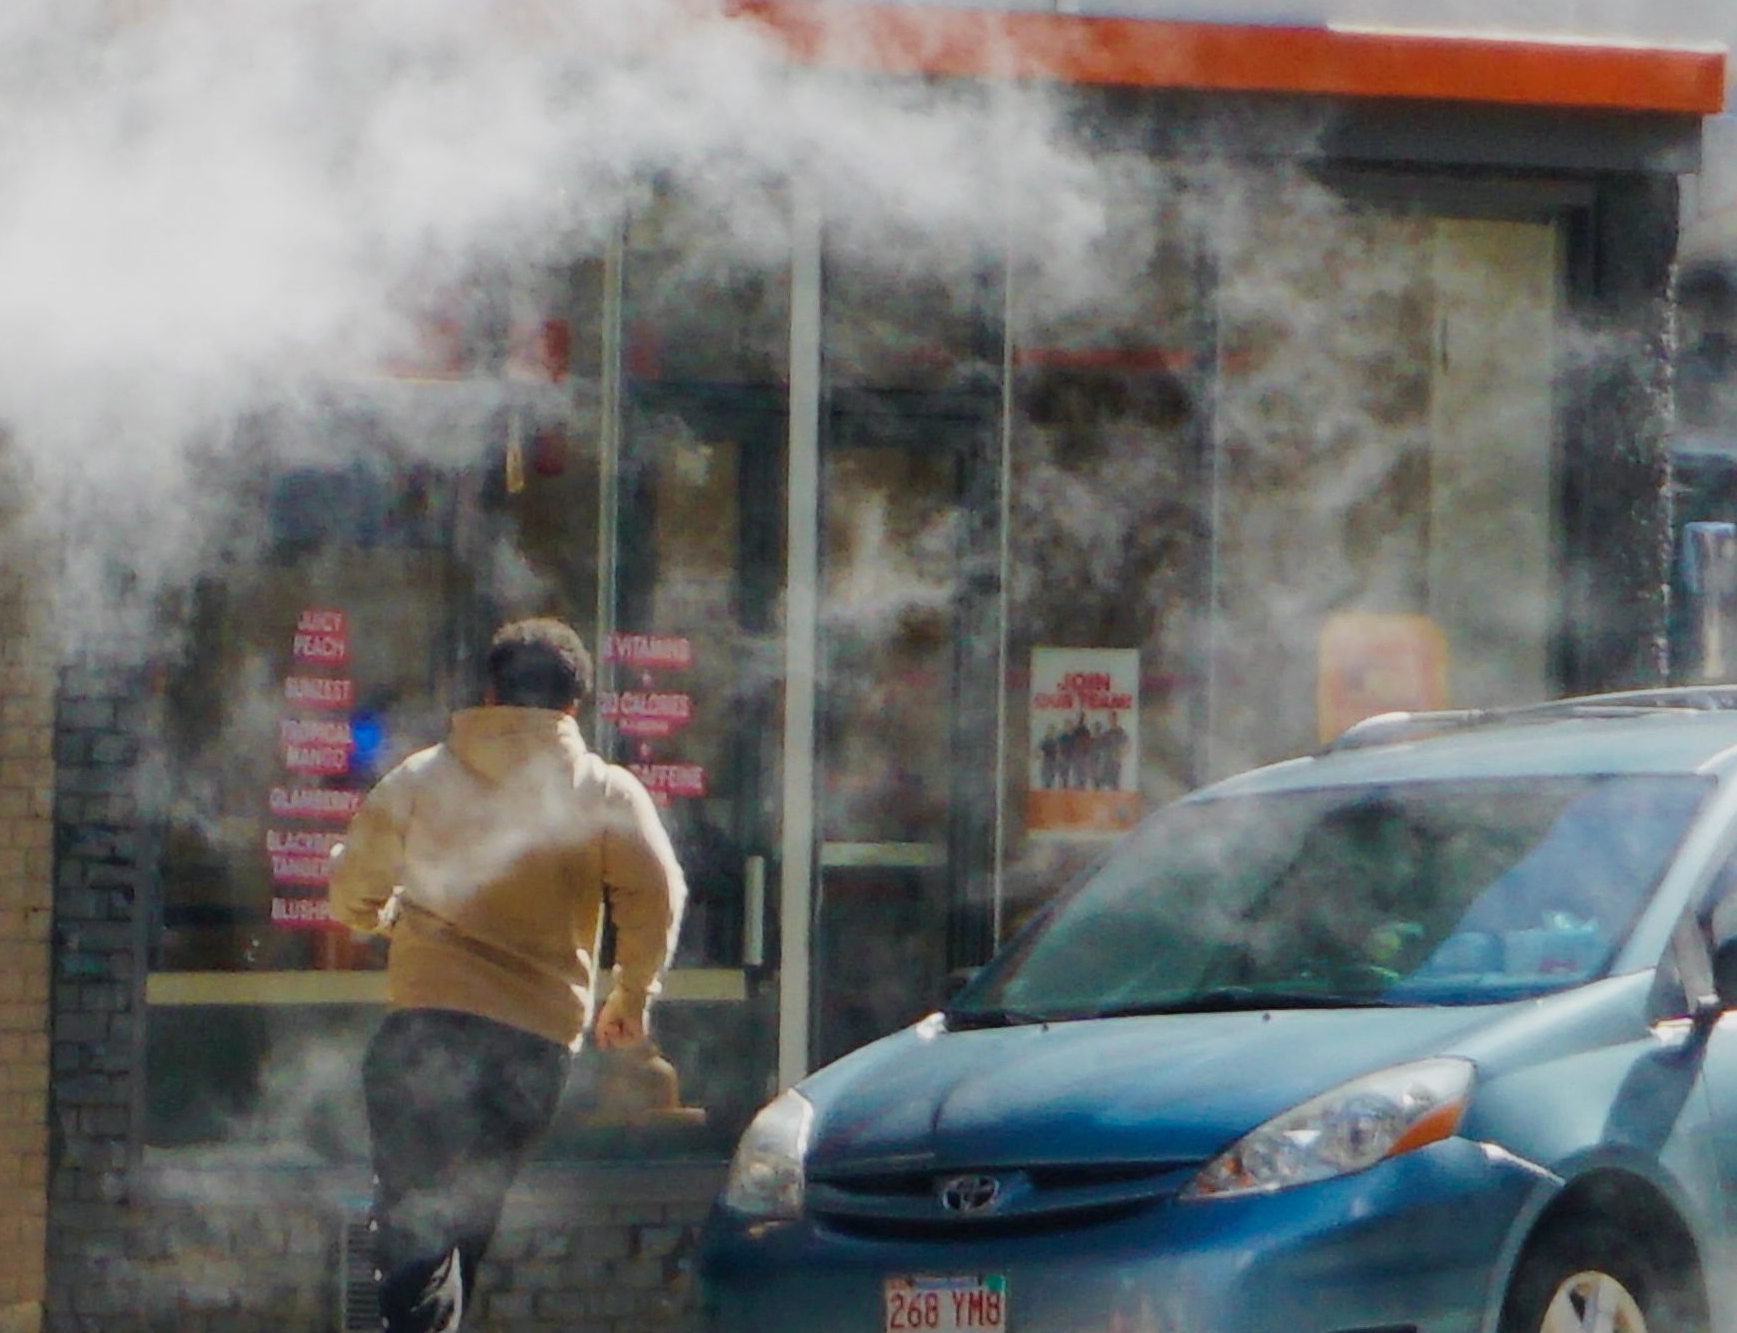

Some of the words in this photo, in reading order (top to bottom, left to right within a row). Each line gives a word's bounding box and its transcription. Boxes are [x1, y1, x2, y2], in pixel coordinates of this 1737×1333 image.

[297, 610, 343, 632] JUICY
[293, 634, 346, 658] PEACH
[615, 635, 691, 662] VITAMINS
[1057, 672, 1111, 692] JOIN
[620, 691, 690, 718] CALORIES
